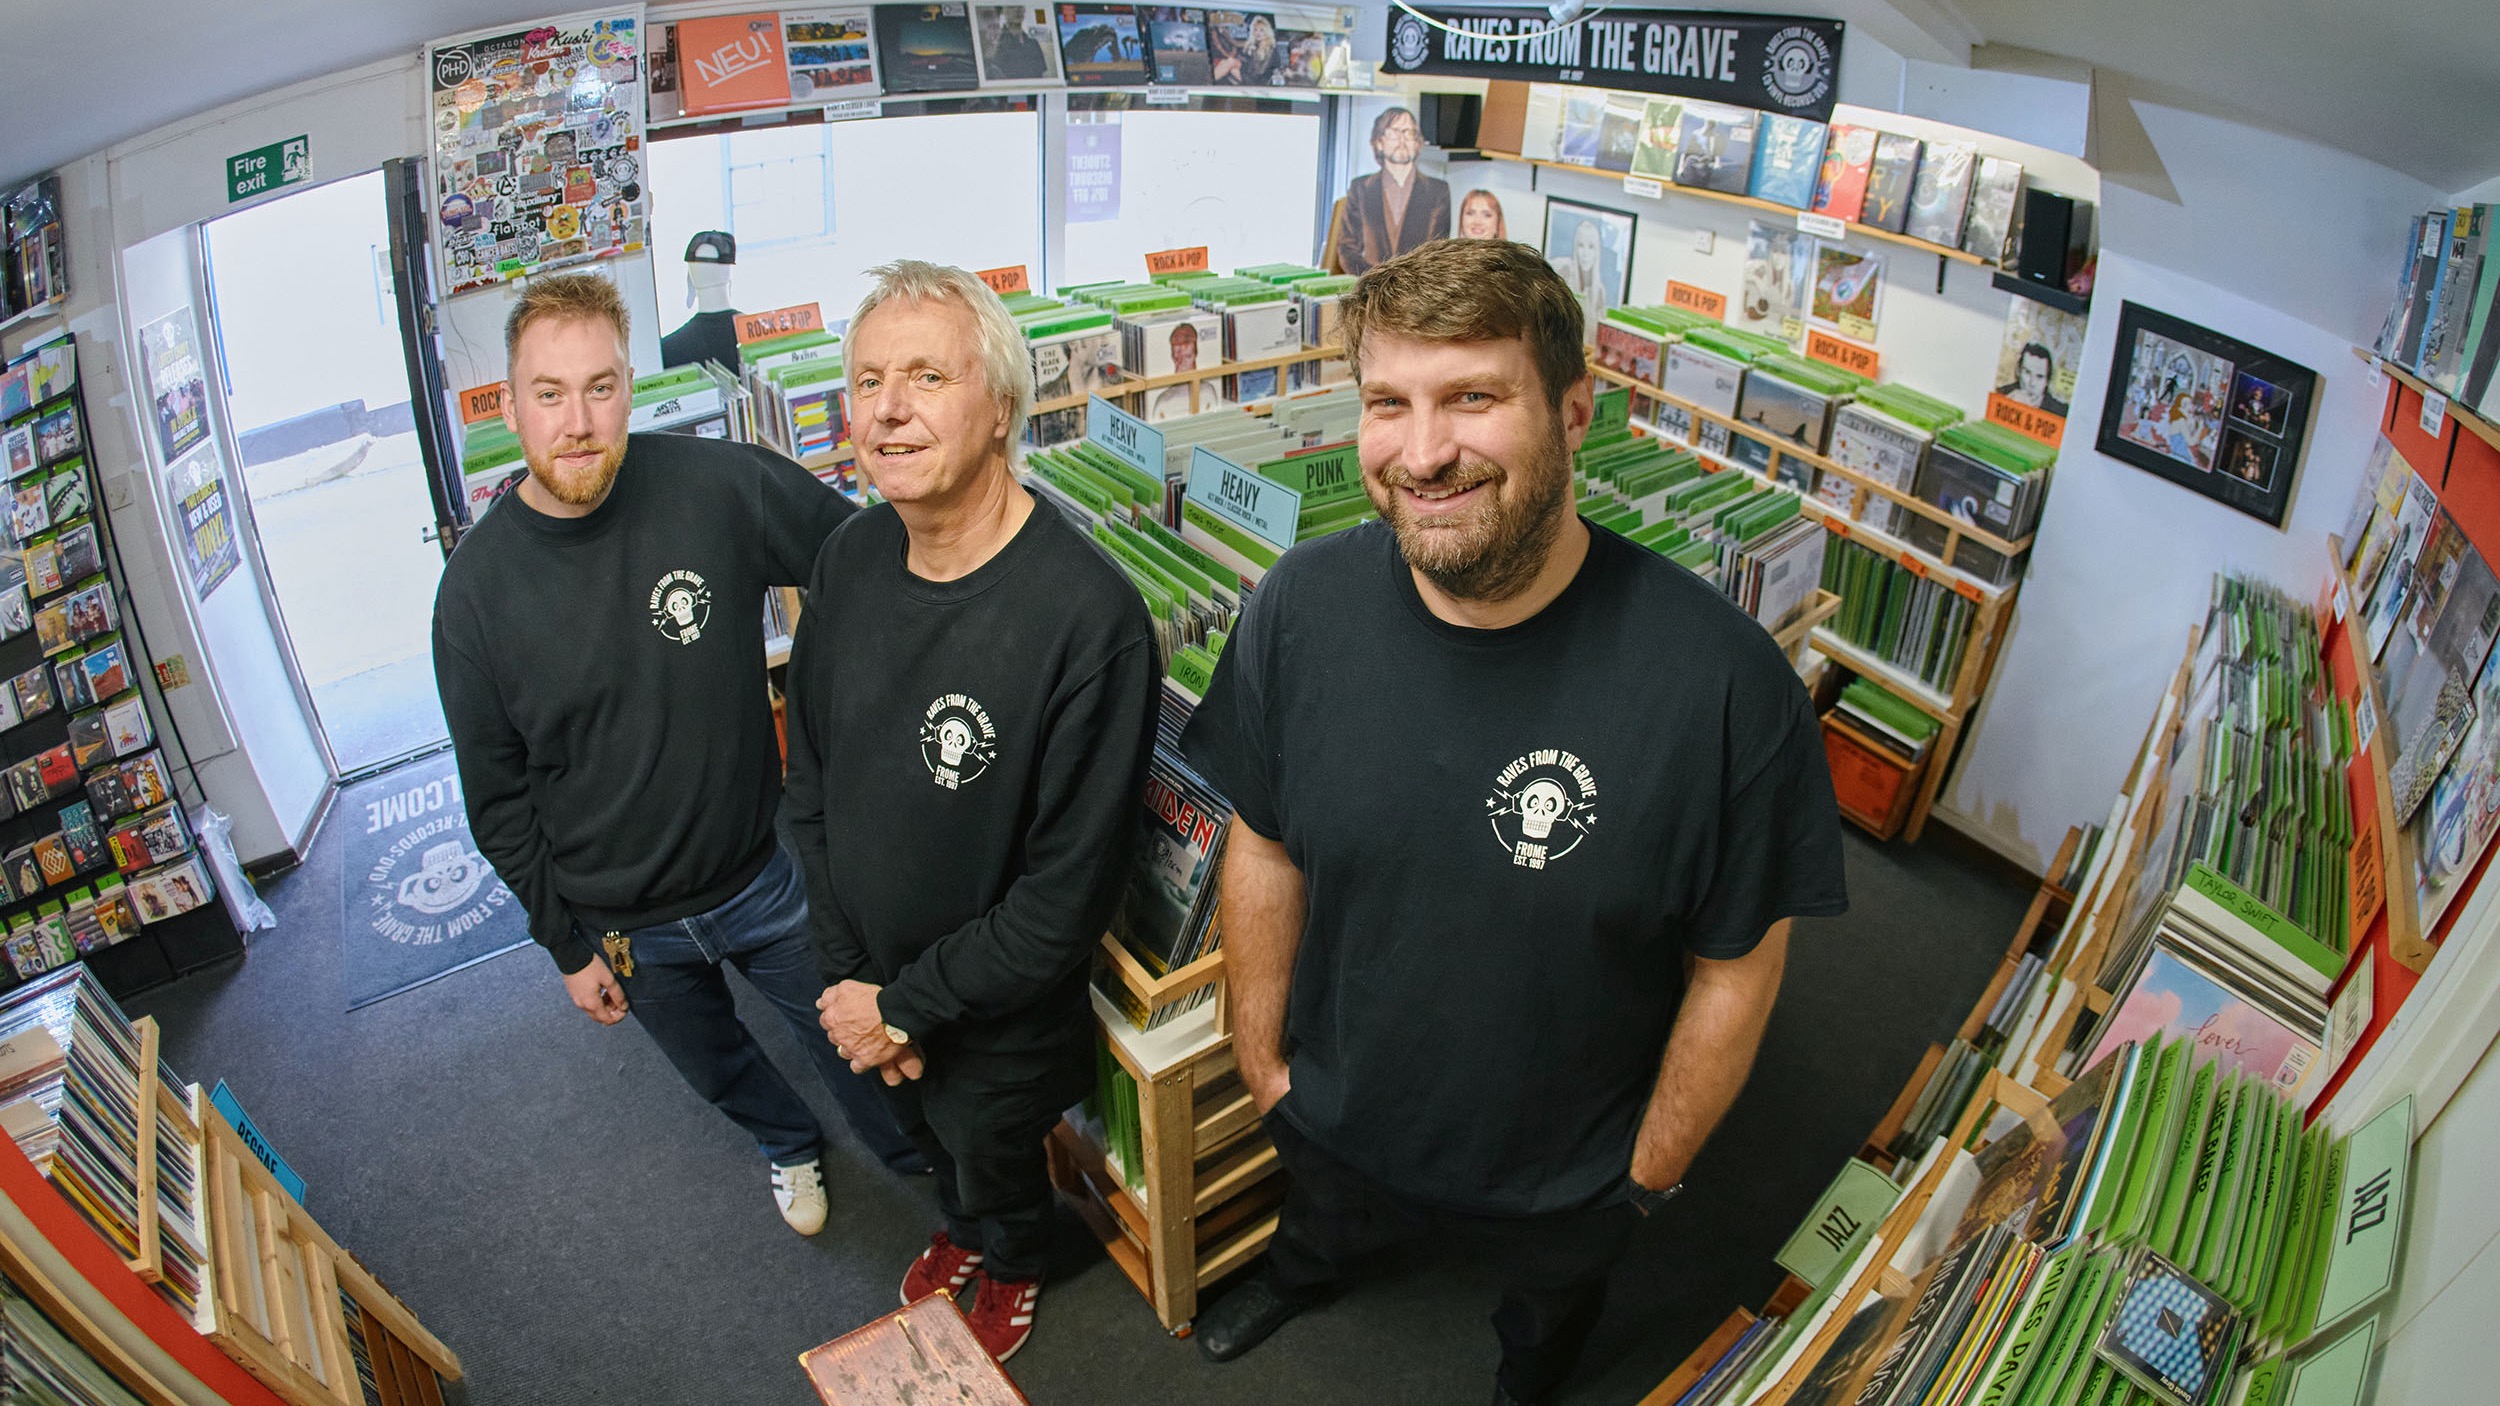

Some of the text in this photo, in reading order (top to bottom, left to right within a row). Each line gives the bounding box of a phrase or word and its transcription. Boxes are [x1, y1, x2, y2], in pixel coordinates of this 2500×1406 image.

[694, 32, 773, 82] NEU!
[1444, 18, 1512, 63] RAVES
[1516, 18, 1582, 67] FROM
[1588, 21, 1638, 71] THE
[1643, 23, 1739, 82] GRAVE
[234, 156, 267, 177] Fire
[236, 172, 267, 194] exit
[1153, 252, 1202, 269] ROCK & POP
[991, 276, 999, 290] &
[1001, 273, 1019, 287] POP
[747, 310, 812, 338] ROCK & POP
[1815, 338, 1870, 369] ROCK & POP
[1110, 415, 1137, 449] HEAVY
[1995, 403, 2057, 439] ROCK & POP
[1220, 470, 1260, 512] HEAVY
[1306, 457, 1345, 489] PUNK
[188, 507, 203, 531] NEW
[206, 492, 222, 514] USED
[1227, 502, 1241, 516] CLASSIC
[1241, 510, 1251, 522] ROCK
[1255, 516, 1268, 531] METAL
[192, 512, 229, 560] VINYL
[650, 570, 705, 609] RAVES FROM THE GRAVE
[1180, 662, 1205, 689] IRON
[926, 694, 996, 739] RAVES FROM THE GRAVE
[935, 765, 960, 783] FROME
[1496, 749, 1597, 799] RAVES FROM THE GRAVE
[366, 774, 464, 834] LCOME
[1144, 779, 1216, 863] AIDEN
[1513, 856, 1545, 870] EST. 1997
[1515, 840, 1548, 860] FROME
[2197, 869, 2280, 932] TAYLOR SWIFT
[372, 902, 493, 945] FROM THE GRAVE
[2187, 1013, 2259, 1055] Lover
[2211, 1089, 2231, 1127] CHET
[2197, 1137, 2219, 1193] BAKER
[2346, 1167, 2393, 1247] JAZZ
[1816, 1205, 1862, 1253] JAZZ
[2023, 1258, 2069, 1332] MILES
[2160, 1375, 2192, 1403] David Gray
